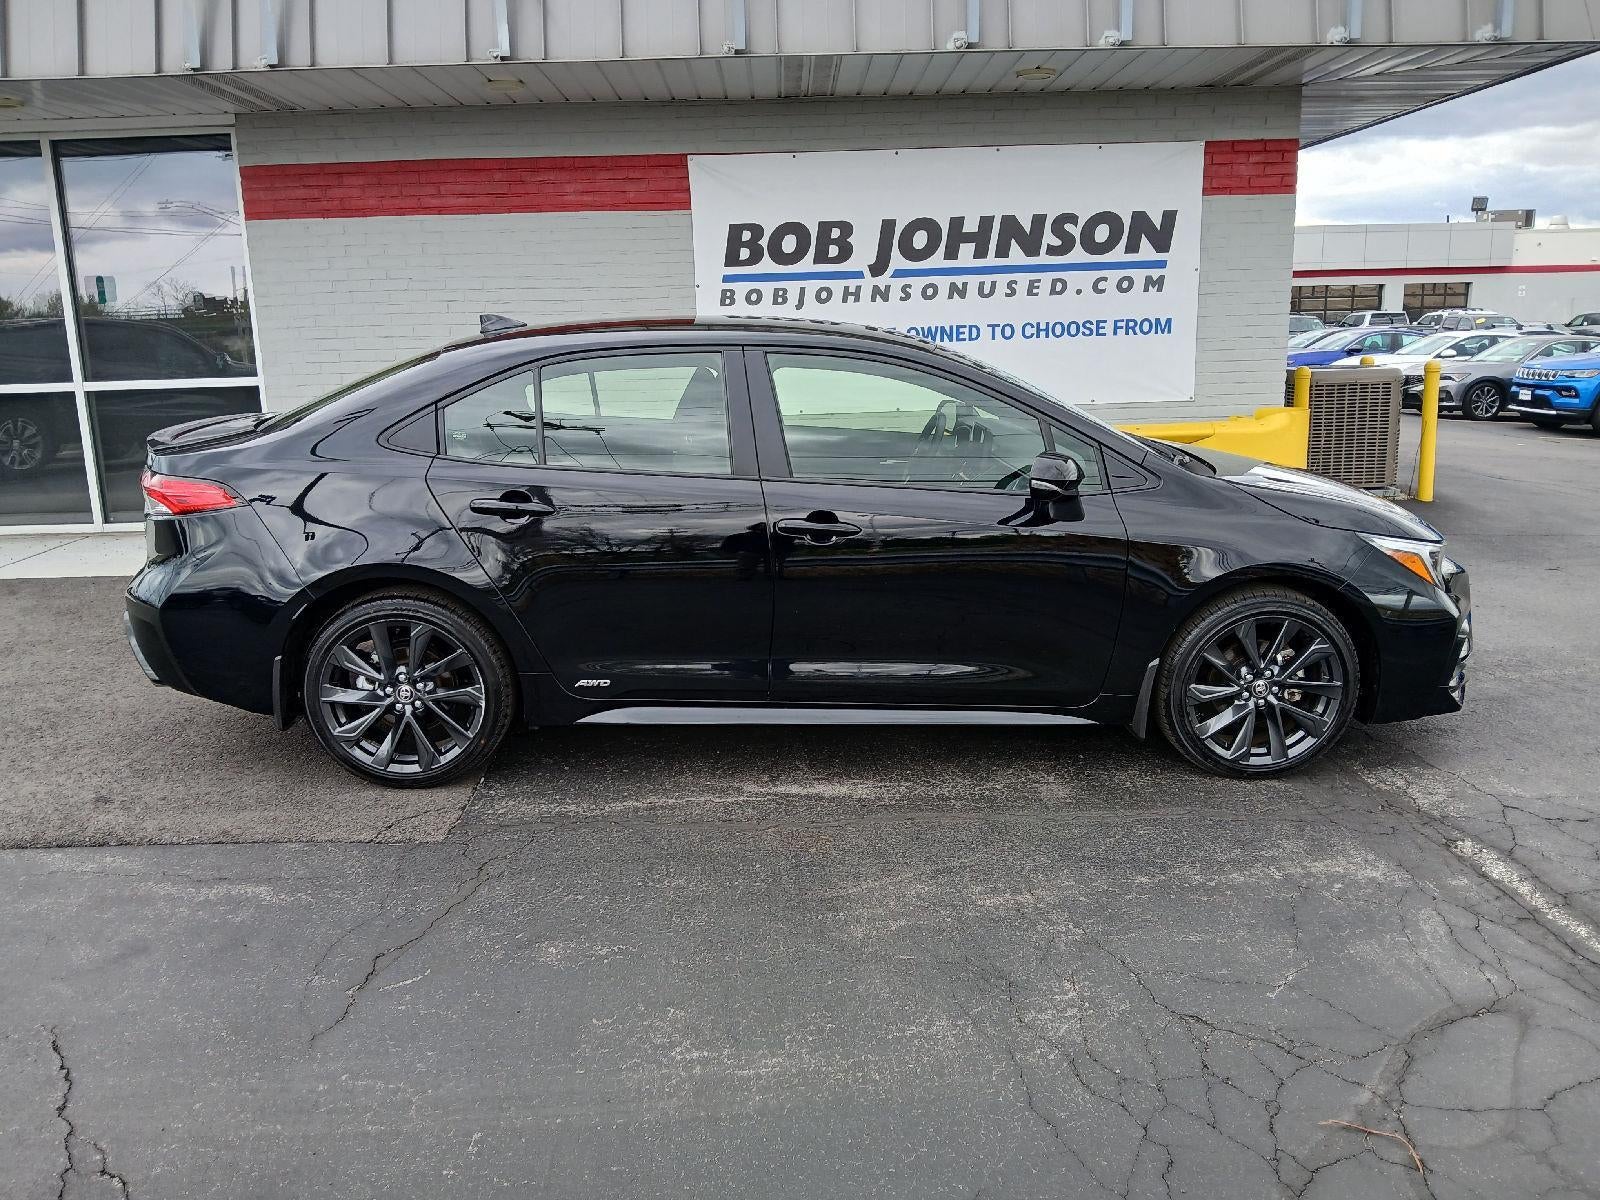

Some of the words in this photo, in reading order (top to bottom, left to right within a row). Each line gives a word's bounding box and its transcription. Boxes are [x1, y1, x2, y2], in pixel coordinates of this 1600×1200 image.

[724, 221, 854, 267] BOB
[867, 210, 1178, 278] JOHNSON
[719, 275, 1166, 310] BOBJOHNSONUSED.COM
[987, 322, 1016, 340] TO
[1021, 319, 1107, 339] CHOOSE
[1112, 317, 1173, 336] FROM
[574, 679, 611, 687] AWD
